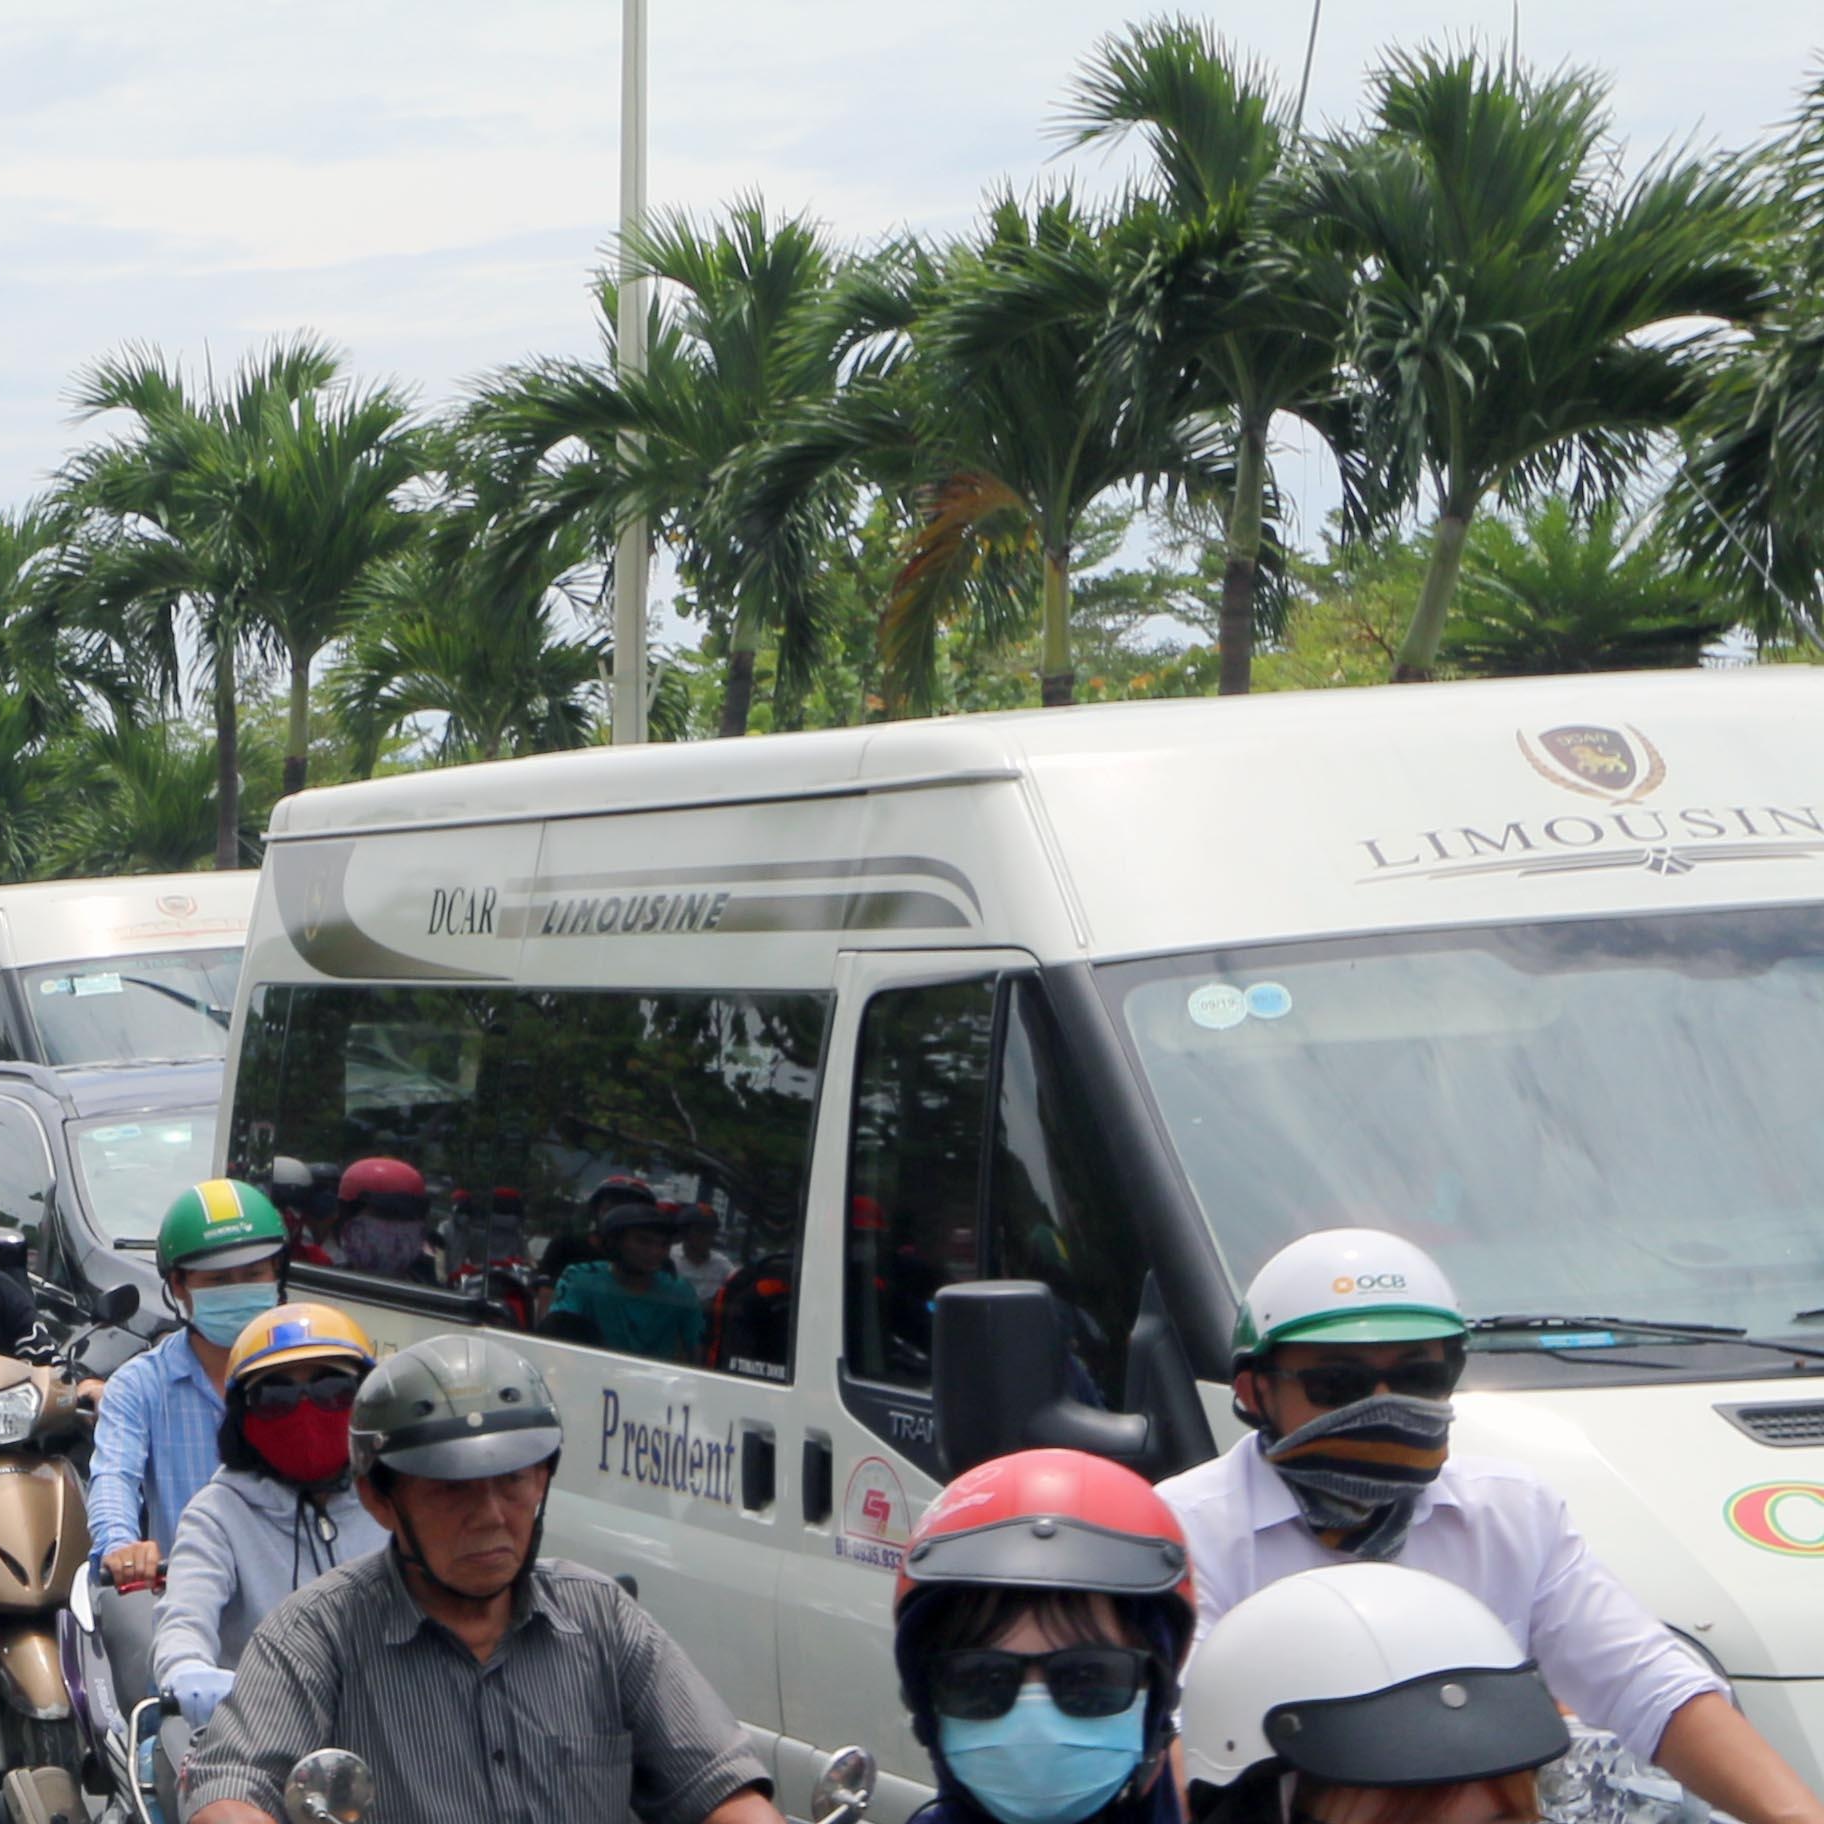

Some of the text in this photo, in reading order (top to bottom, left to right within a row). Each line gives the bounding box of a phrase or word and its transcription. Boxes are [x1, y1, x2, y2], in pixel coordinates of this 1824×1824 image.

[427, 887, 730, 935] DCAR LIMOUSINE
[1356, 1274, 1406, 1289] OCB
[598, 1388, 736, 1504] President
